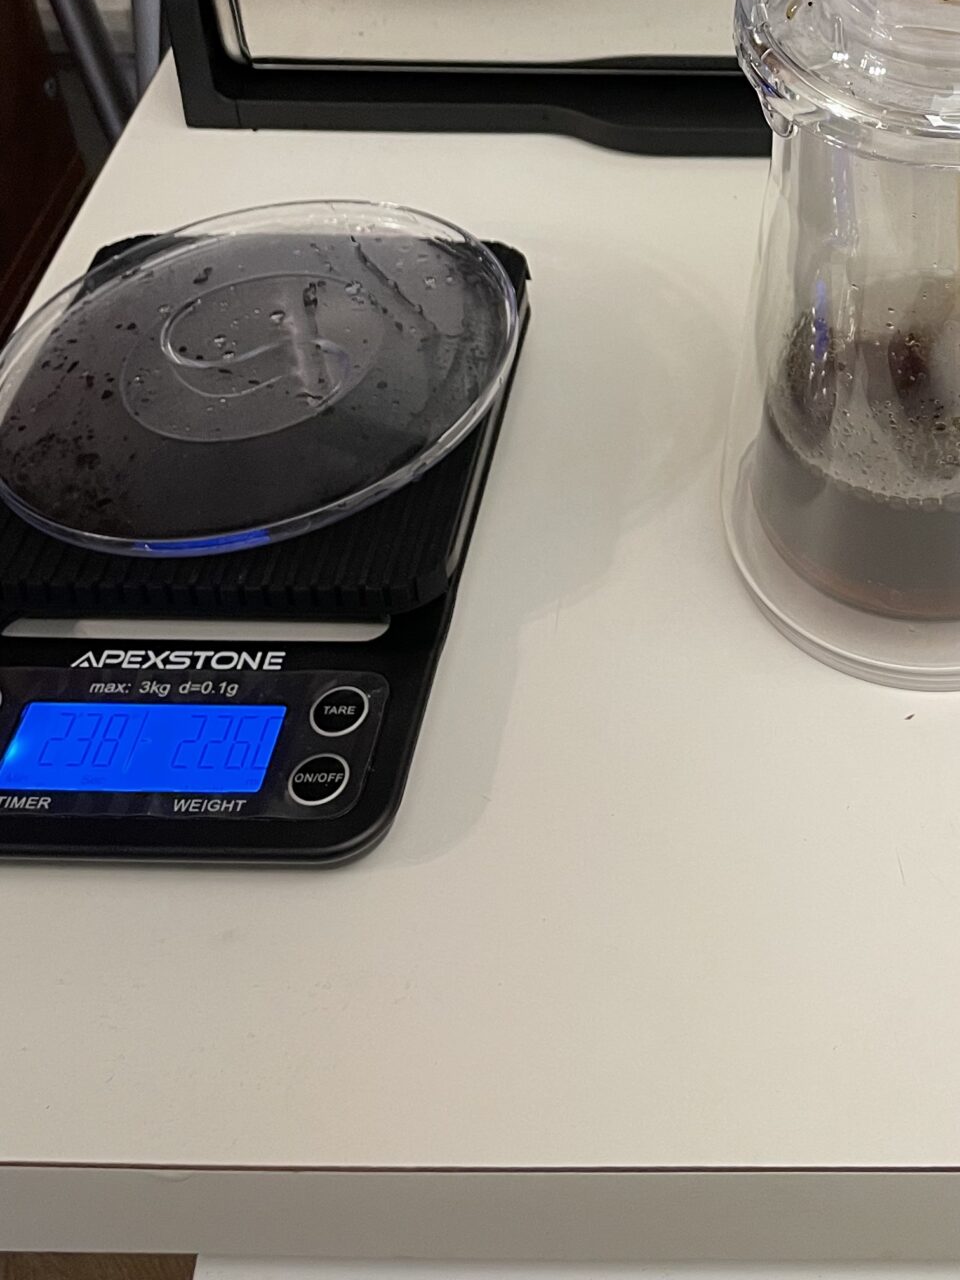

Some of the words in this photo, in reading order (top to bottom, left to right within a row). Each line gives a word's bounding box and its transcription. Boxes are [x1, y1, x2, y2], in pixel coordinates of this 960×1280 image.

[70, 650, 286, 670] APEXSTONE
[89, 682, 132, 694] max:
[138, 680, 171, 697] 3kg
[178, 681, 240, 697] d=0.1g
[323, 705, 356, 715] TARE
[294, 772, 344, 783] ON/OFF
[0, 796, 52, 809] TIMER
[173, 799, 247, 812] WEIGHT
